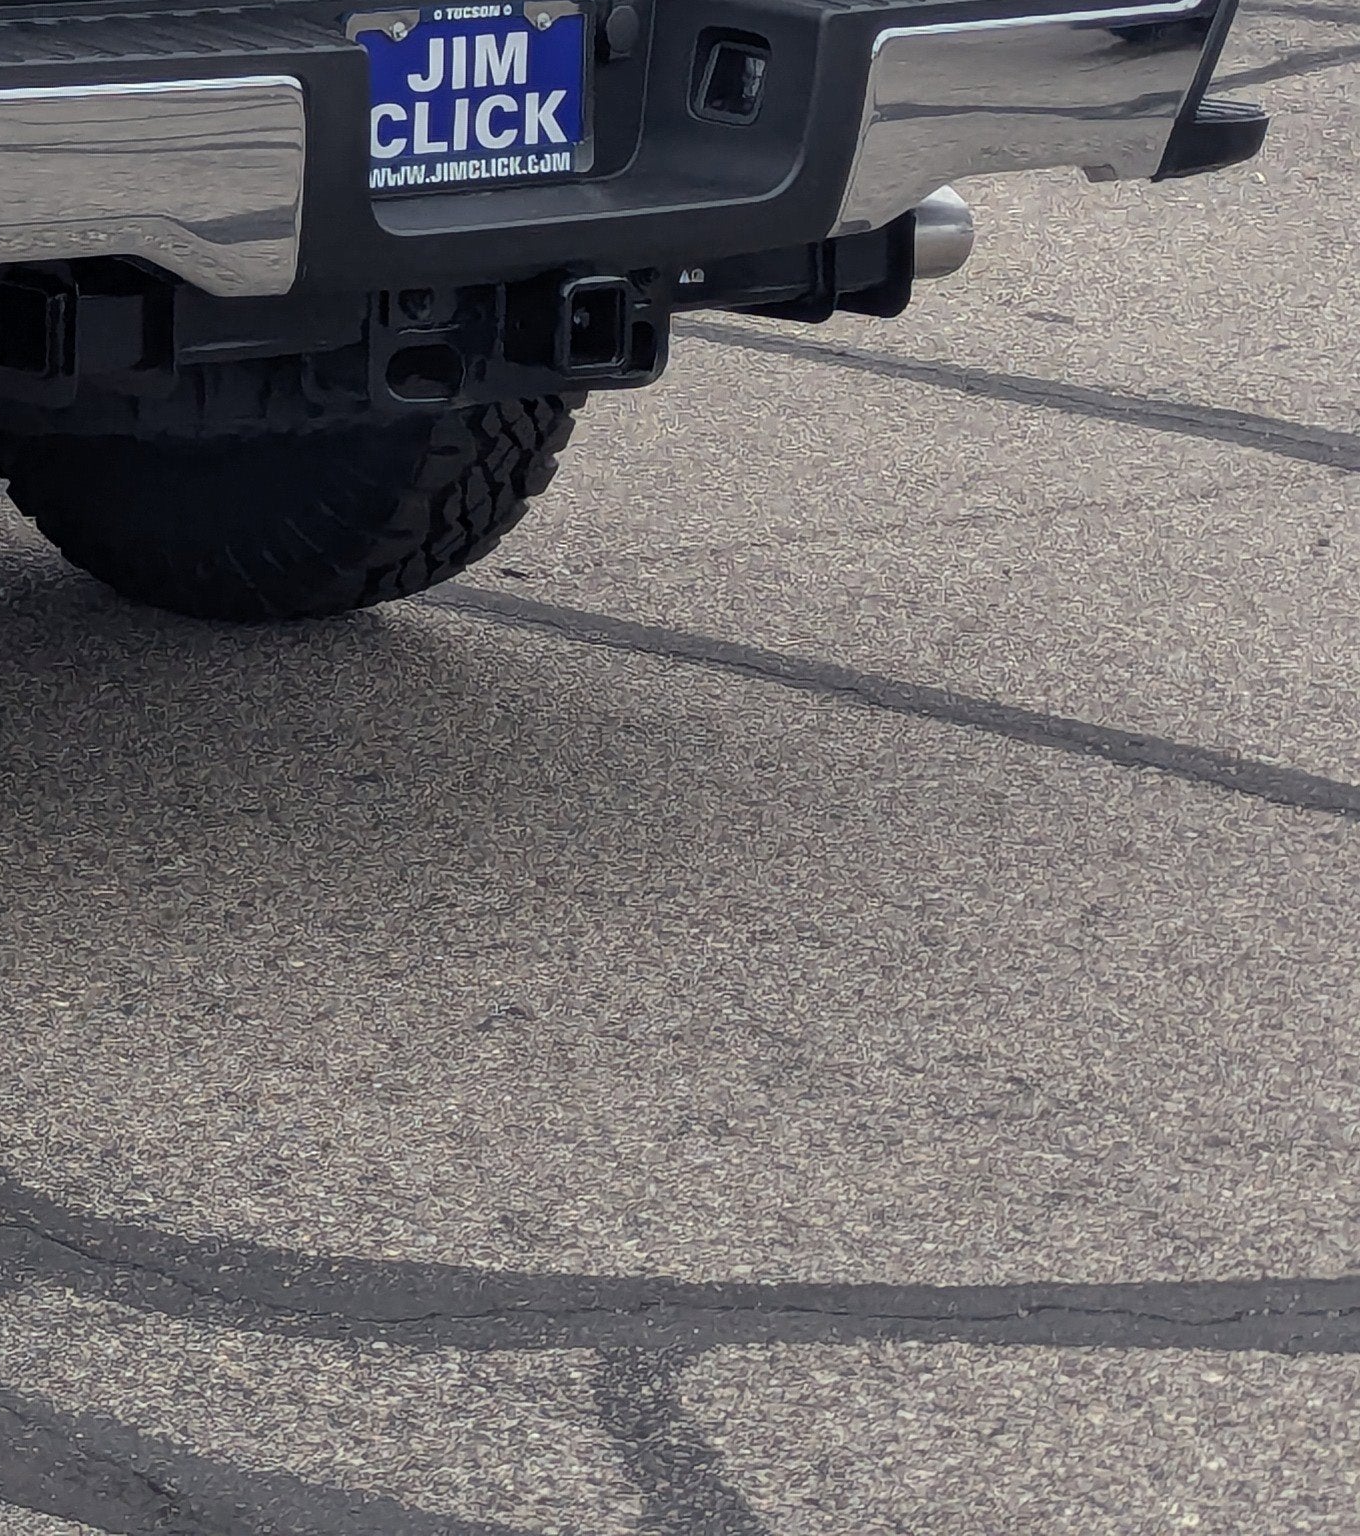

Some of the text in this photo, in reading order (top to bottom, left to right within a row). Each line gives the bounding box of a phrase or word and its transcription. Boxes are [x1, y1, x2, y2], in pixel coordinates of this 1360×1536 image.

[445, 4, 501, 20] TUCSON
[407, 31, 529, 92] JIM
[370, 90, 568, 159] CLICK
[369, 151, 571, 189] WWW.JIMCLICK.COM
